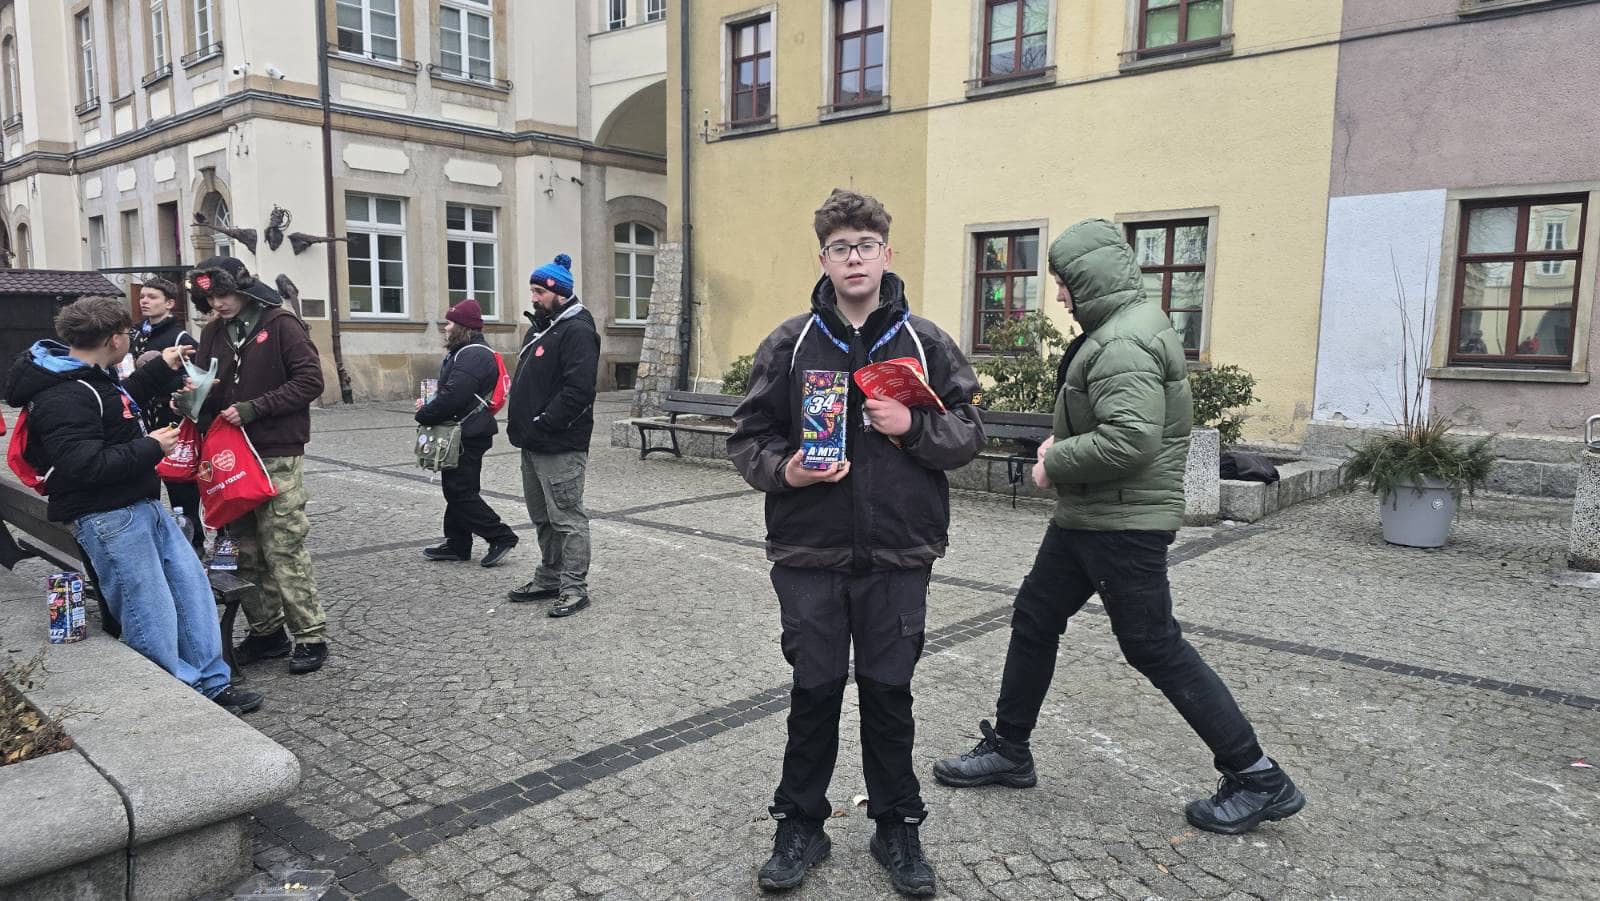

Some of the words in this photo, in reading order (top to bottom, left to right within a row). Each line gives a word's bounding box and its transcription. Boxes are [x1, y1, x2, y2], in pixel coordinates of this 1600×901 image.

[808, 393, 836, 414] 34
[807, 447, 816, 457] A
[817, 447, 839, 457] MY?
